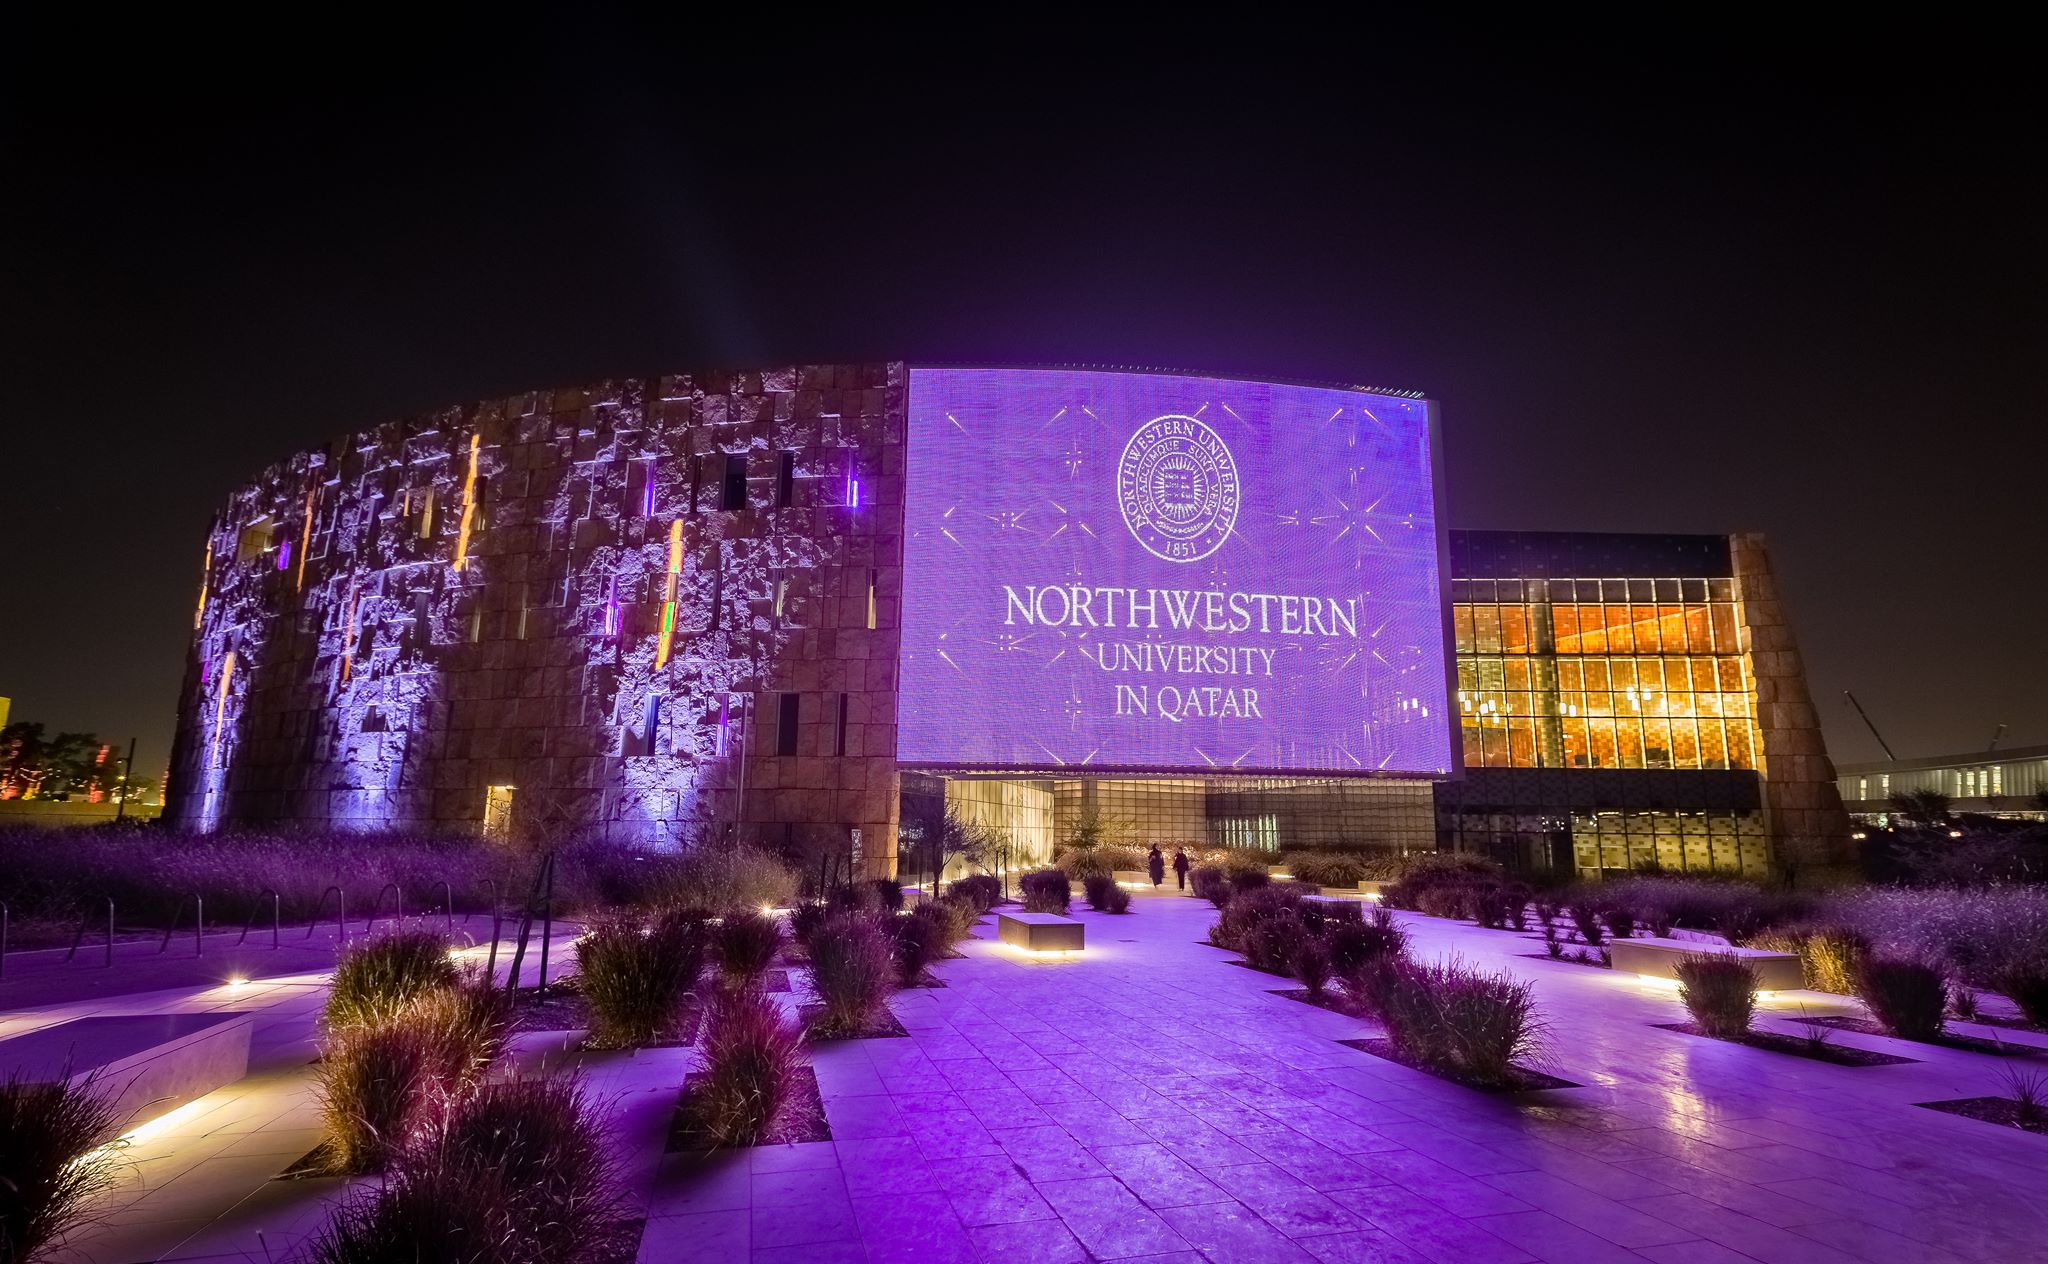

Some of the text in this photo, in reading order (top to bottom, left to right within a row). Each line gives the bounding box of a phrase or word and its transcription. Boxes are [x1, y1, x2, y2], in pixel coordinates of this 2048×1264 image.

[1188, 445, 1215, 472] SUNT
[1123, 421, 1235, 536] NORTHWESTERN UNIVERSITY
[1164, 541, 1198, 557] 1851
[1003, 586, 1359, 637] NORTHWESTERN
[1098, 642, 1277, 676] UNIVERSITY
[1115, 685, 1263, 722] IN QATAR
